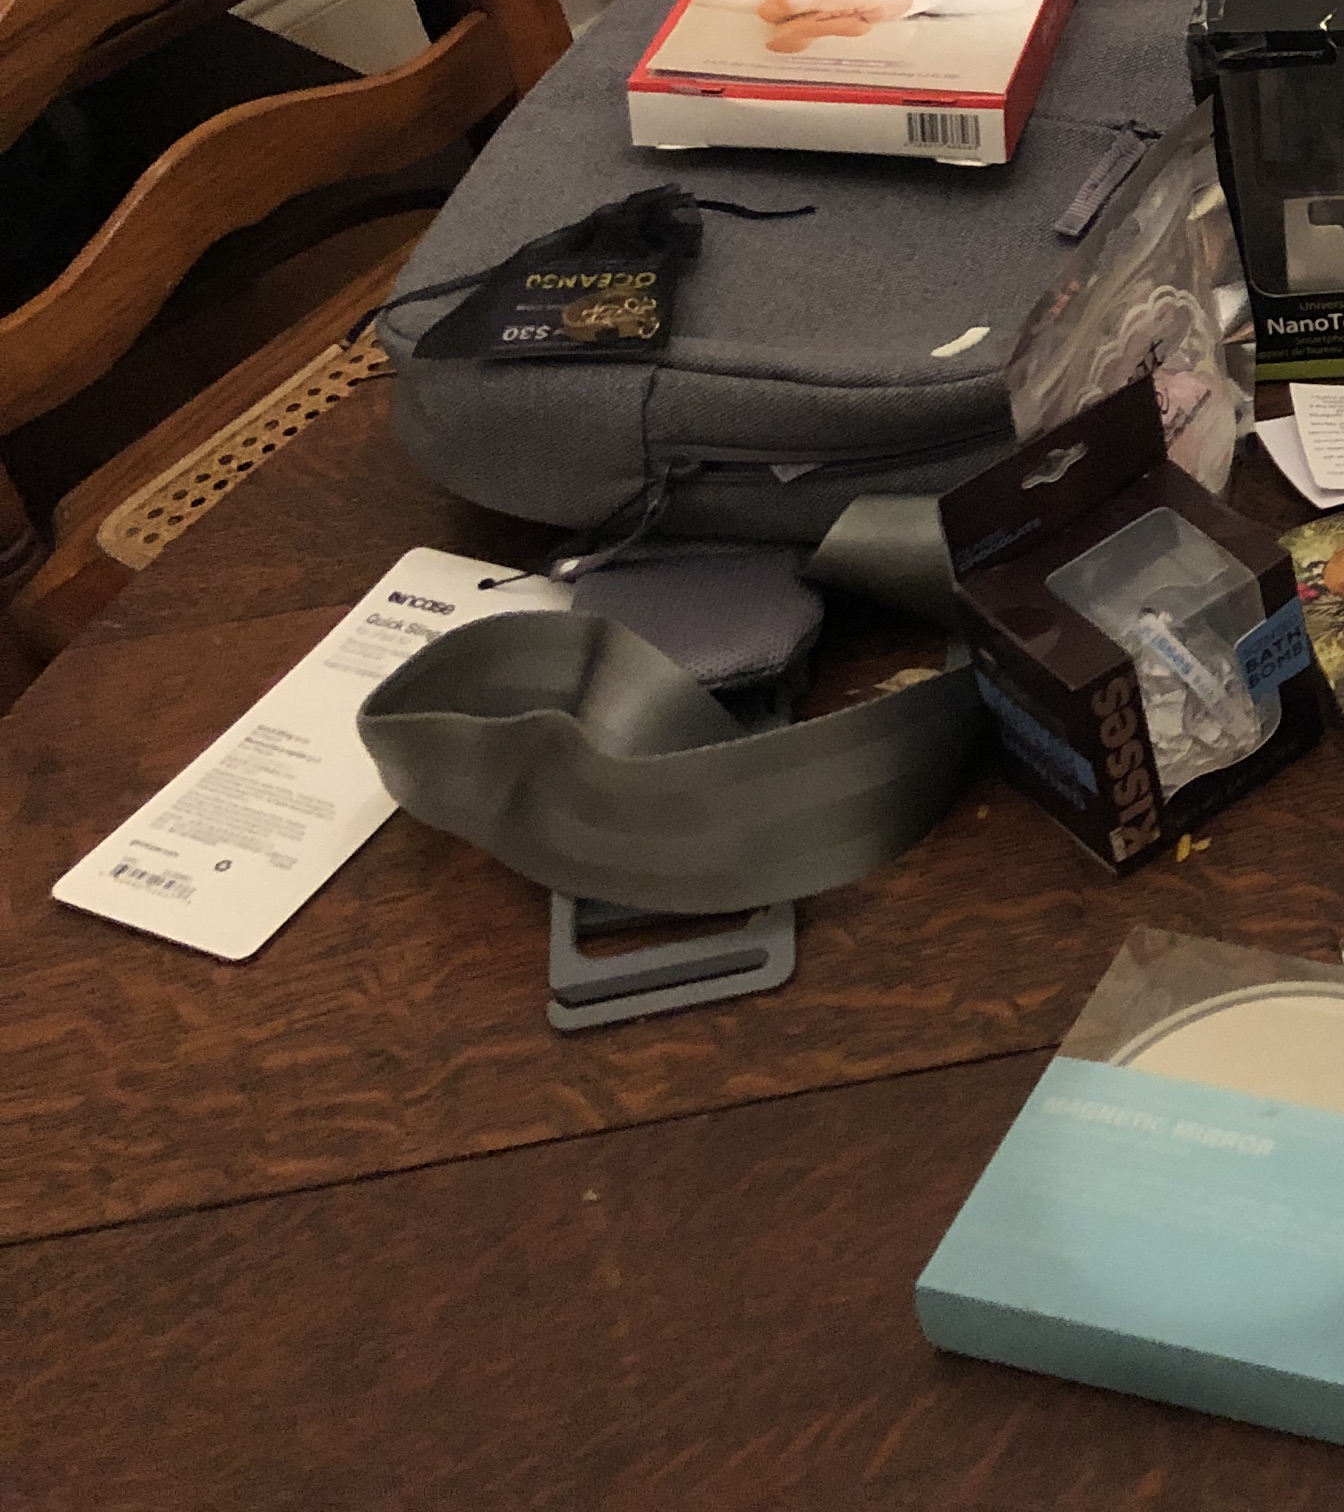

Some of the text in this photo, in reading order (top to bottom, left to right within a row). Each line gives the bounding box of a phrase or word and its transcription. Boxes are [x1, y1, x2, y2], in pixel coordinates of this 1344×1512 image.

[366, 613, 442, 643] Quick Sling
[1245, 628, 1303, 676] BATH
[1246, 641, 1306, 690] BOMB
[1172, 1120, 1275, 1156] MIRROR
